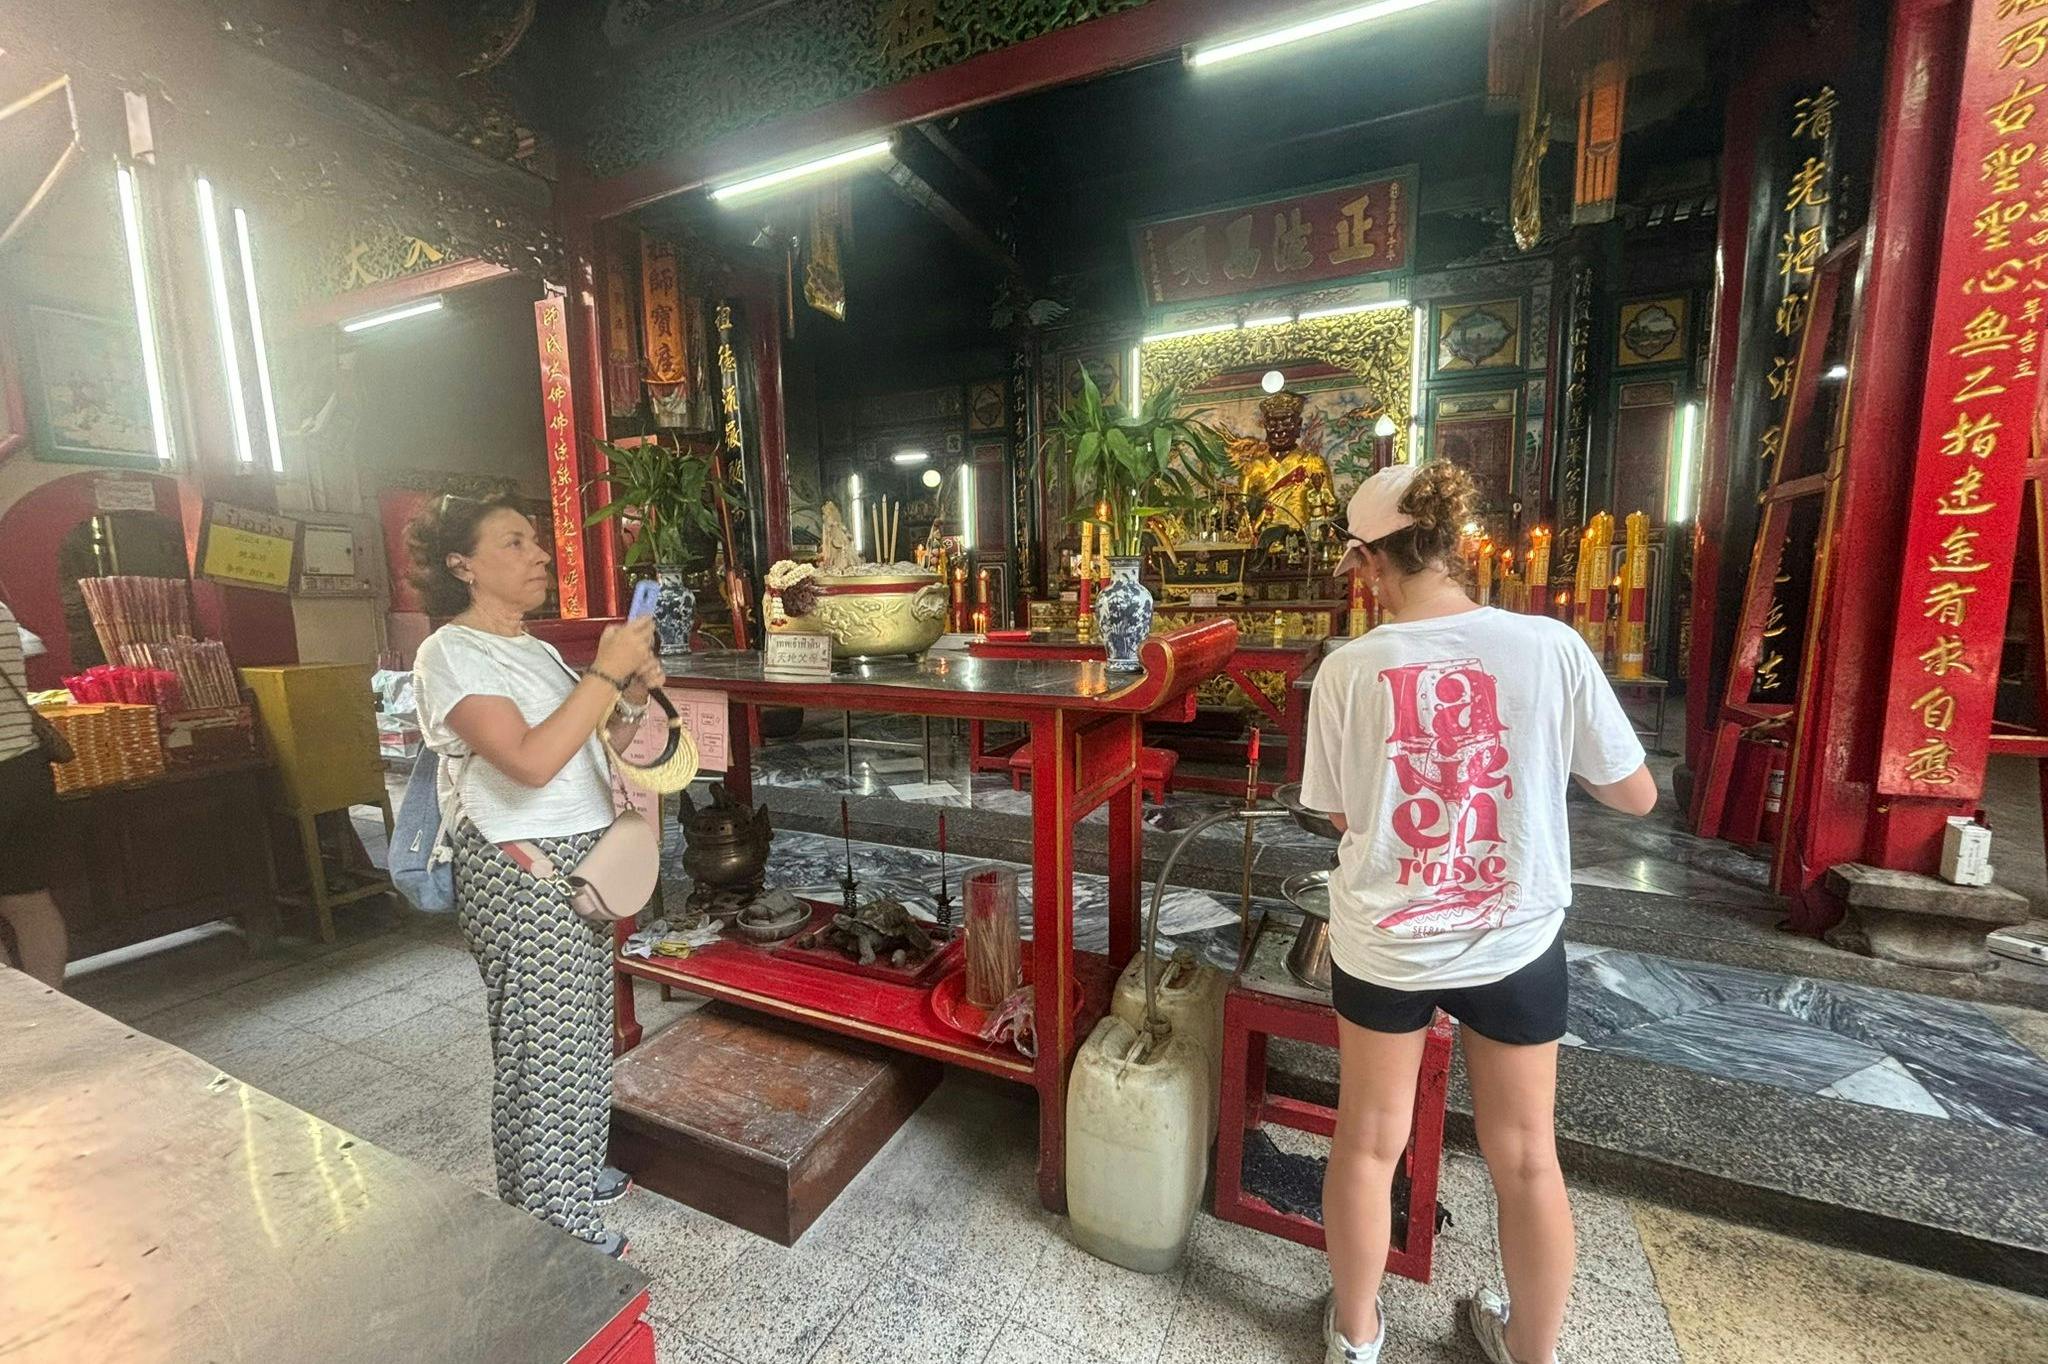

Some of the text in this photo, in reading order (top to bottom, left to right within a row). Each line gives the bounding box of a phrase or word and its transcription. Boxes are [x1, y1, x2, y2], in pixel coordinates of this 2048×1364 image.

[1377, 665, 1510, 743] la
[1391, 791, 1508, 856] en
[1397, 844, 1508, 886] rosé
